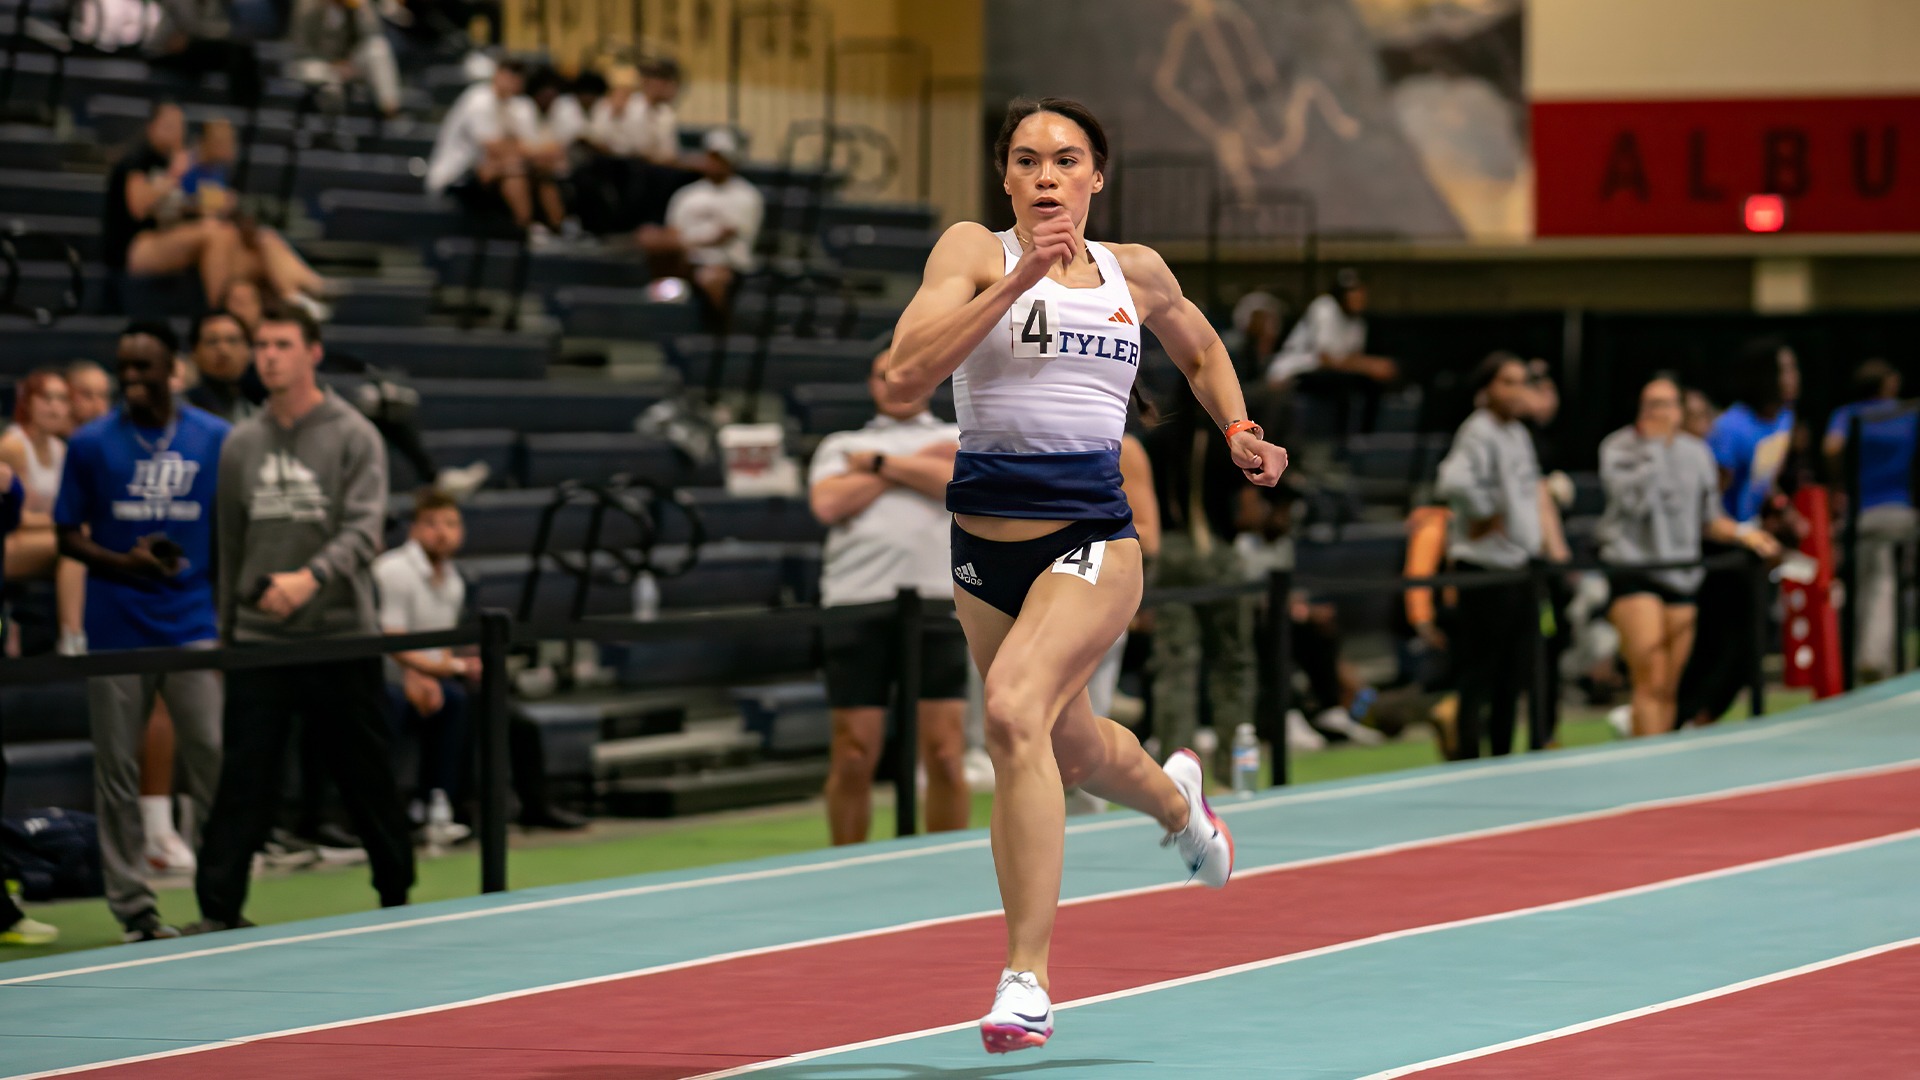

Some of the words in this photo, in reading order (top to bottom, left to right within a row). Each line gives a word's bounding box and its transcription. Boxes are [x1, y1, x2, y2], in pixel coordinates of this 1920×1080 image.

[1602, 127, 1896, 200] ALBU
[1021, 299, 1053, 354] 4
[1059, 331, 1139, 367] TYLER
[1062, 541, 1093, 576] 4
